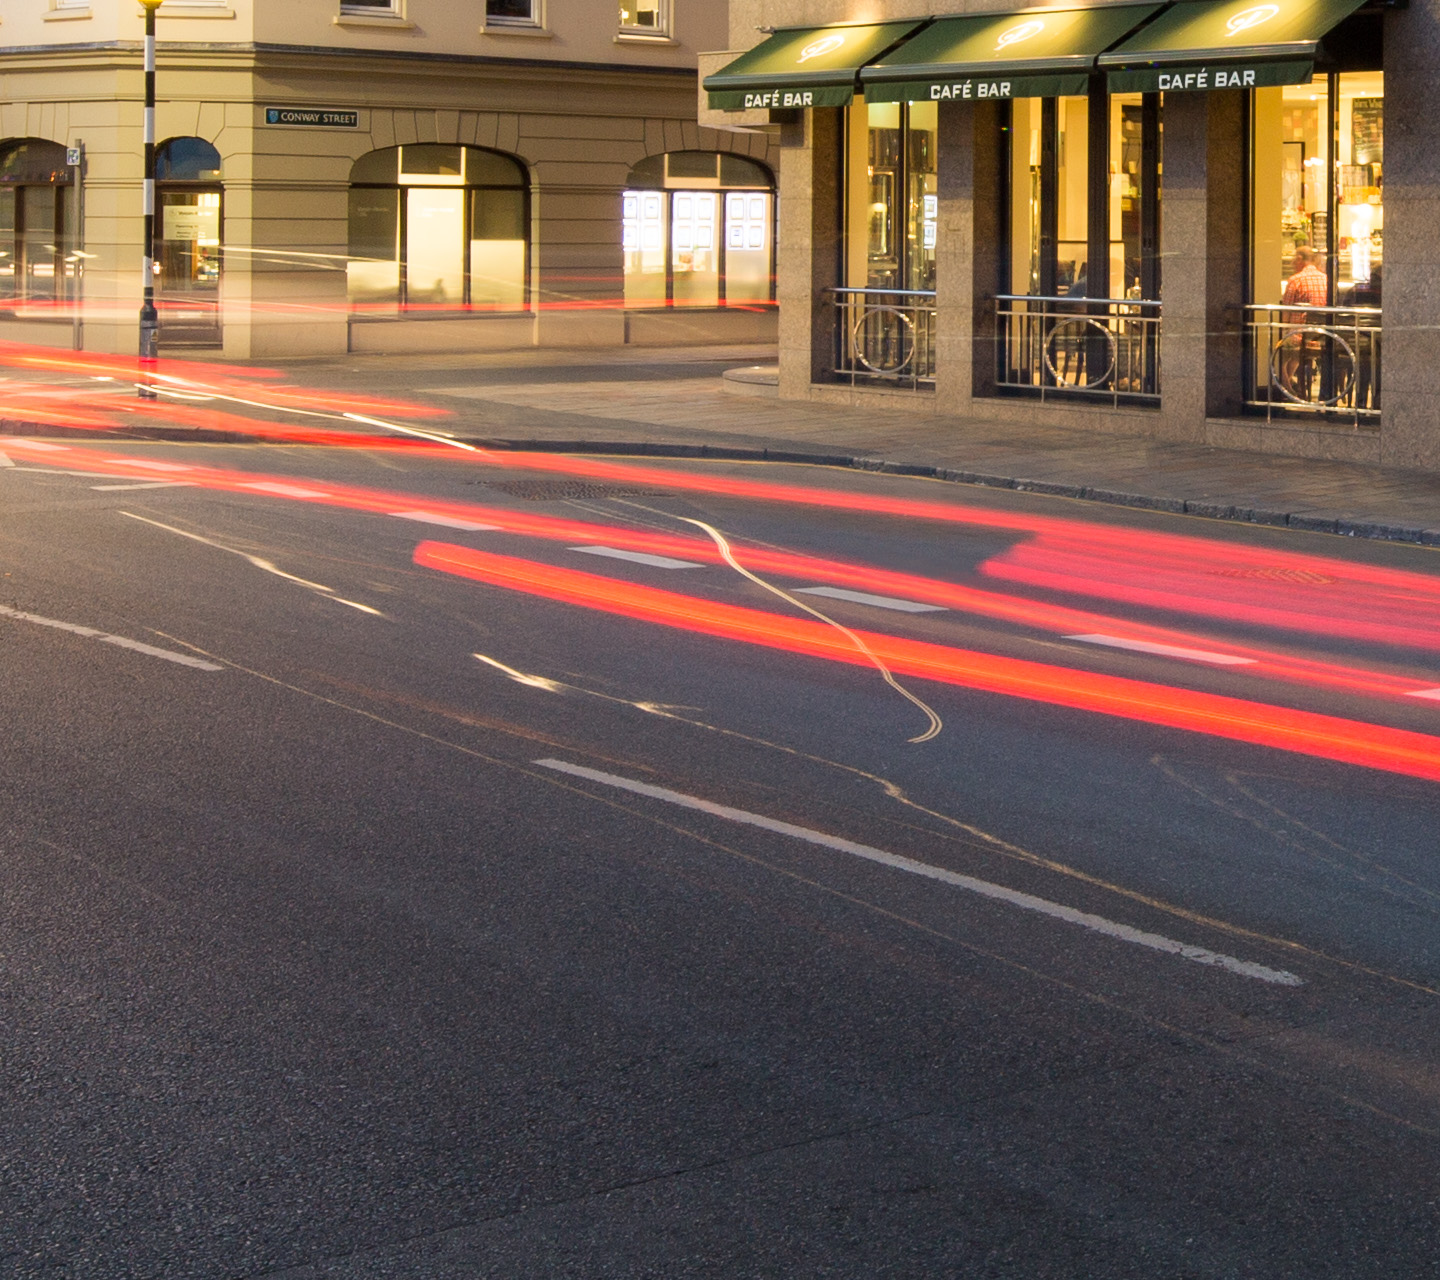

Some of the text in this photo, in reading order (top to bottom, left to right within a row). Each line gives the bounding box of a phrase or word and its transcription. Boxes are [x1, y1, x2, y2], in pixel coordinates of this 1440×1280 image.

[1158, 67, 1256, 90] CAFÉ BAR
[744, 89, 813, 108] CAFÉ BAR
[930, 79, 1011, 100] CAFÉ BAR
[280, 112, 356, 124] CONWAY STREET
